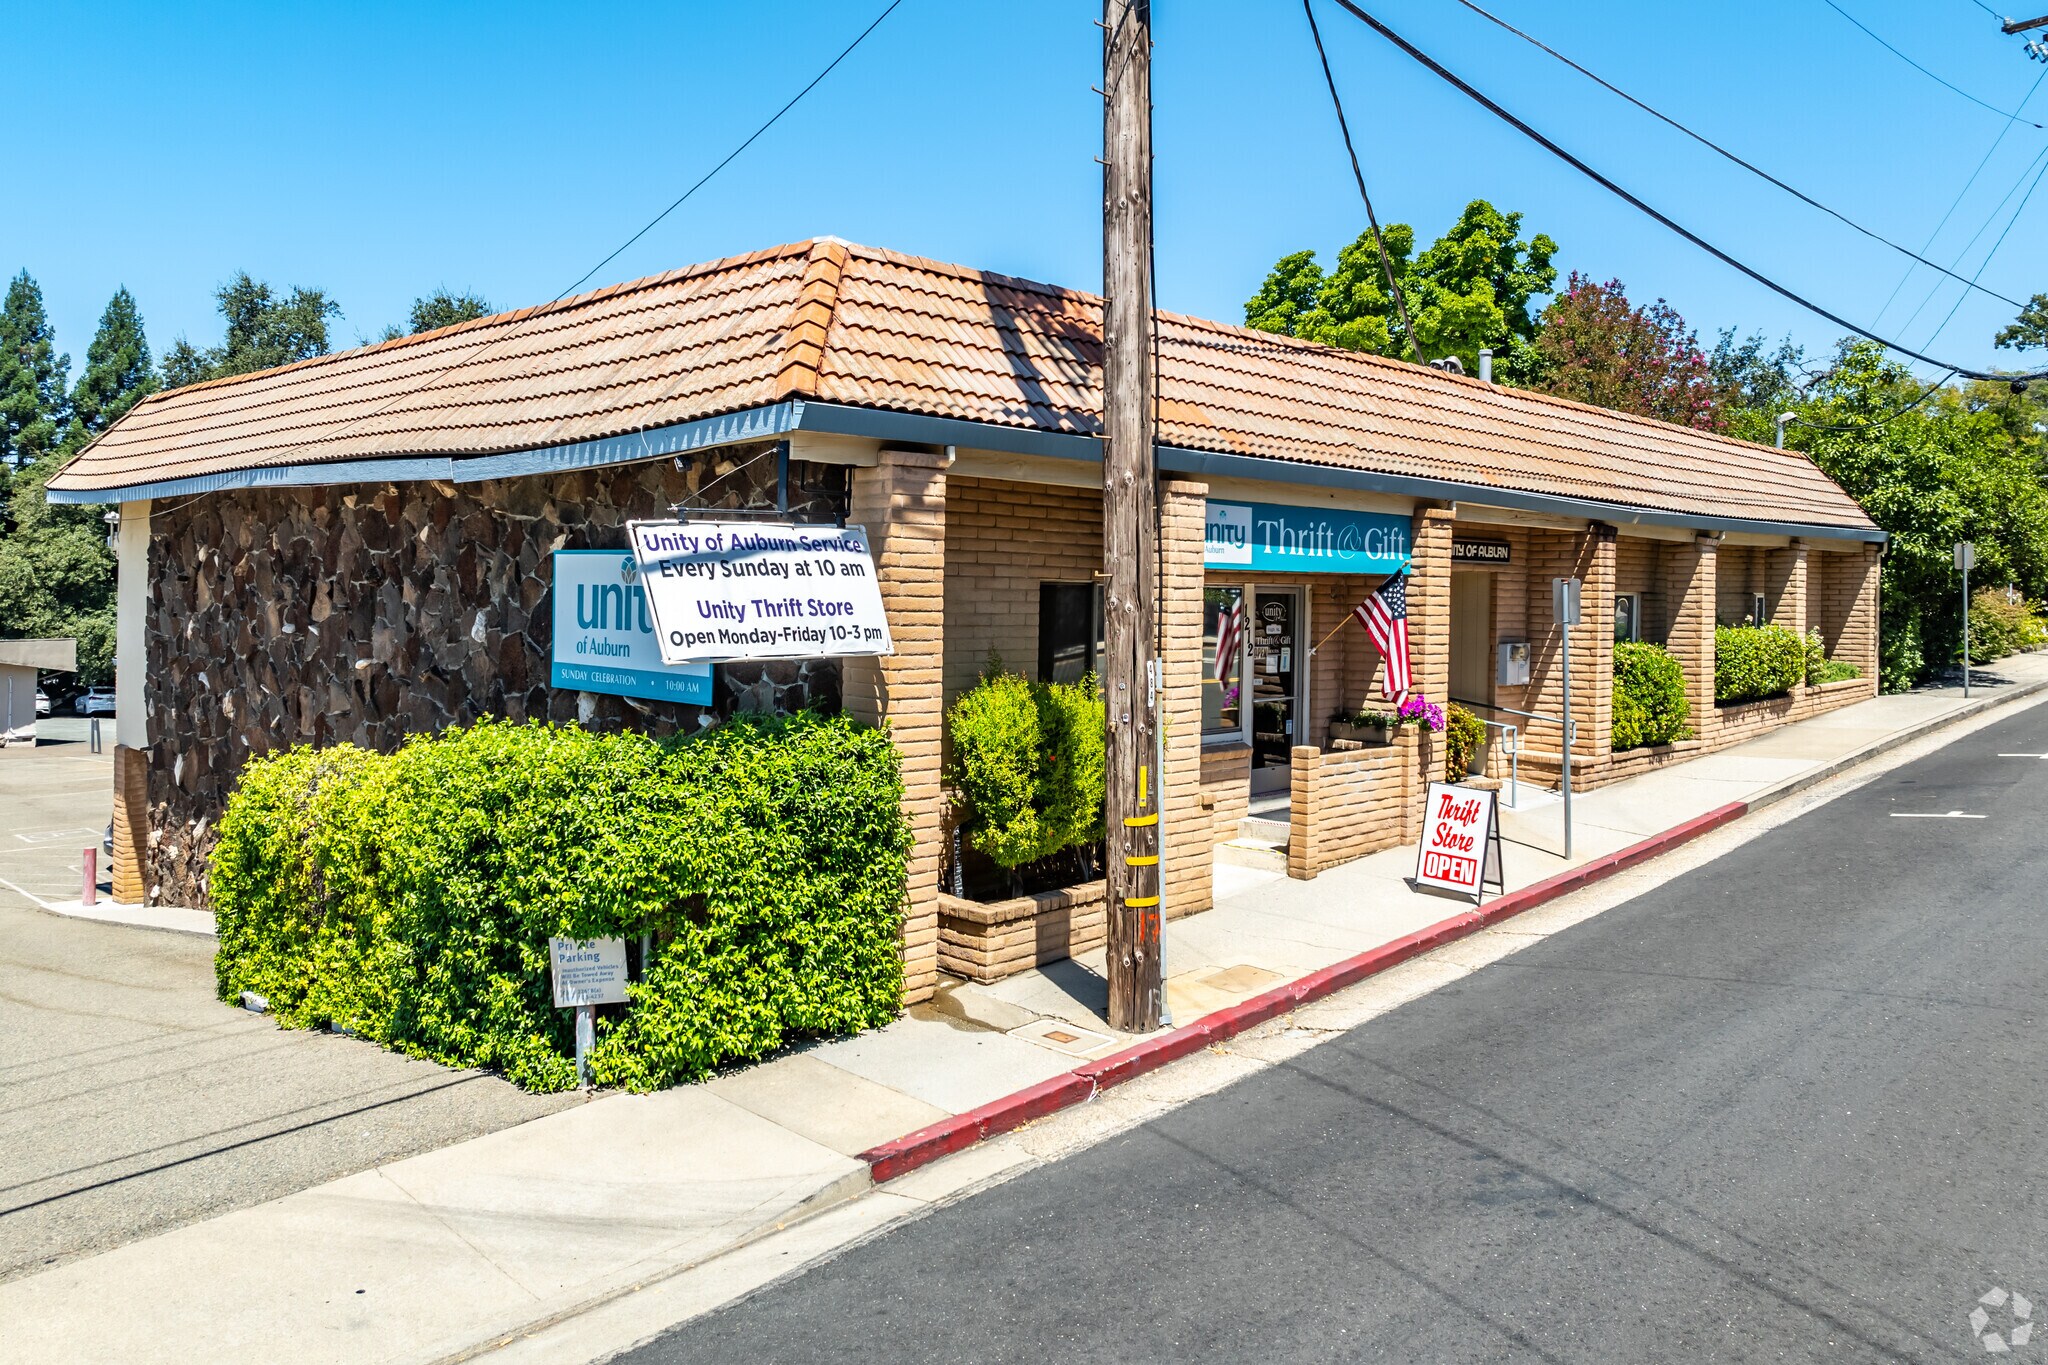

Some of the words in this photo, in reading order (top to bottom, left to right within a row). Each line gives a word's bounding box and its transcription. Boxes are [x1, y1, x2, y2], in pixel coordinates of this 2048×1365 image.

[643, 534, 699, 554] Unity
[705, 533, 723, 551] of
[731, 533, 797, 552] Auburn
[800, 536, 862, 553] Service
[1205, 545, 1225, 554] Auburn
[1257, 518, 1334, 558] Thrift
[1364, 526, 1405, 561] Gift
[1465, 544, 1477, 557] OF
[1478, 545, 1509, 559] AUBURN
[659, 559, 715, 580] Every
[720, 558, 789, 580] Sunday
[795, 559, 812, 577] at
[814, 559, 836, 577] 10
[840, 562, 865, 577] am
[577, 584, 653, 634] unit
[697, 600, 746, 623] Unity
[751, 598, 803, 618] Thrift
[808, 598, 854, 617] Store
[670, 630, 716, 648] Open
[718, 626, 826, 645] Monday-Friday
[829, 625, 861, 640] 10-3
[864, 627, 883, 643] pm
[1244, 604, 1254, 657] 1212
[576, 636, 588, 654] of
[589, 637, 630, 658] Auburn
[561, 668, 589, 681] SUNDAY
[591, 671, 637, 686] CELEBRATION
[665, 680, 685, 692] 10:00
[687, 681, 699, 693] AM
[1437, 793, 1481, 827] Thrift
[1432, 822, 1474, 852] Store
[1425, 853, 1475, 884] OPEN
[558, 941, 595, 950] Prite
[559, 952, 600, 963] Parking
